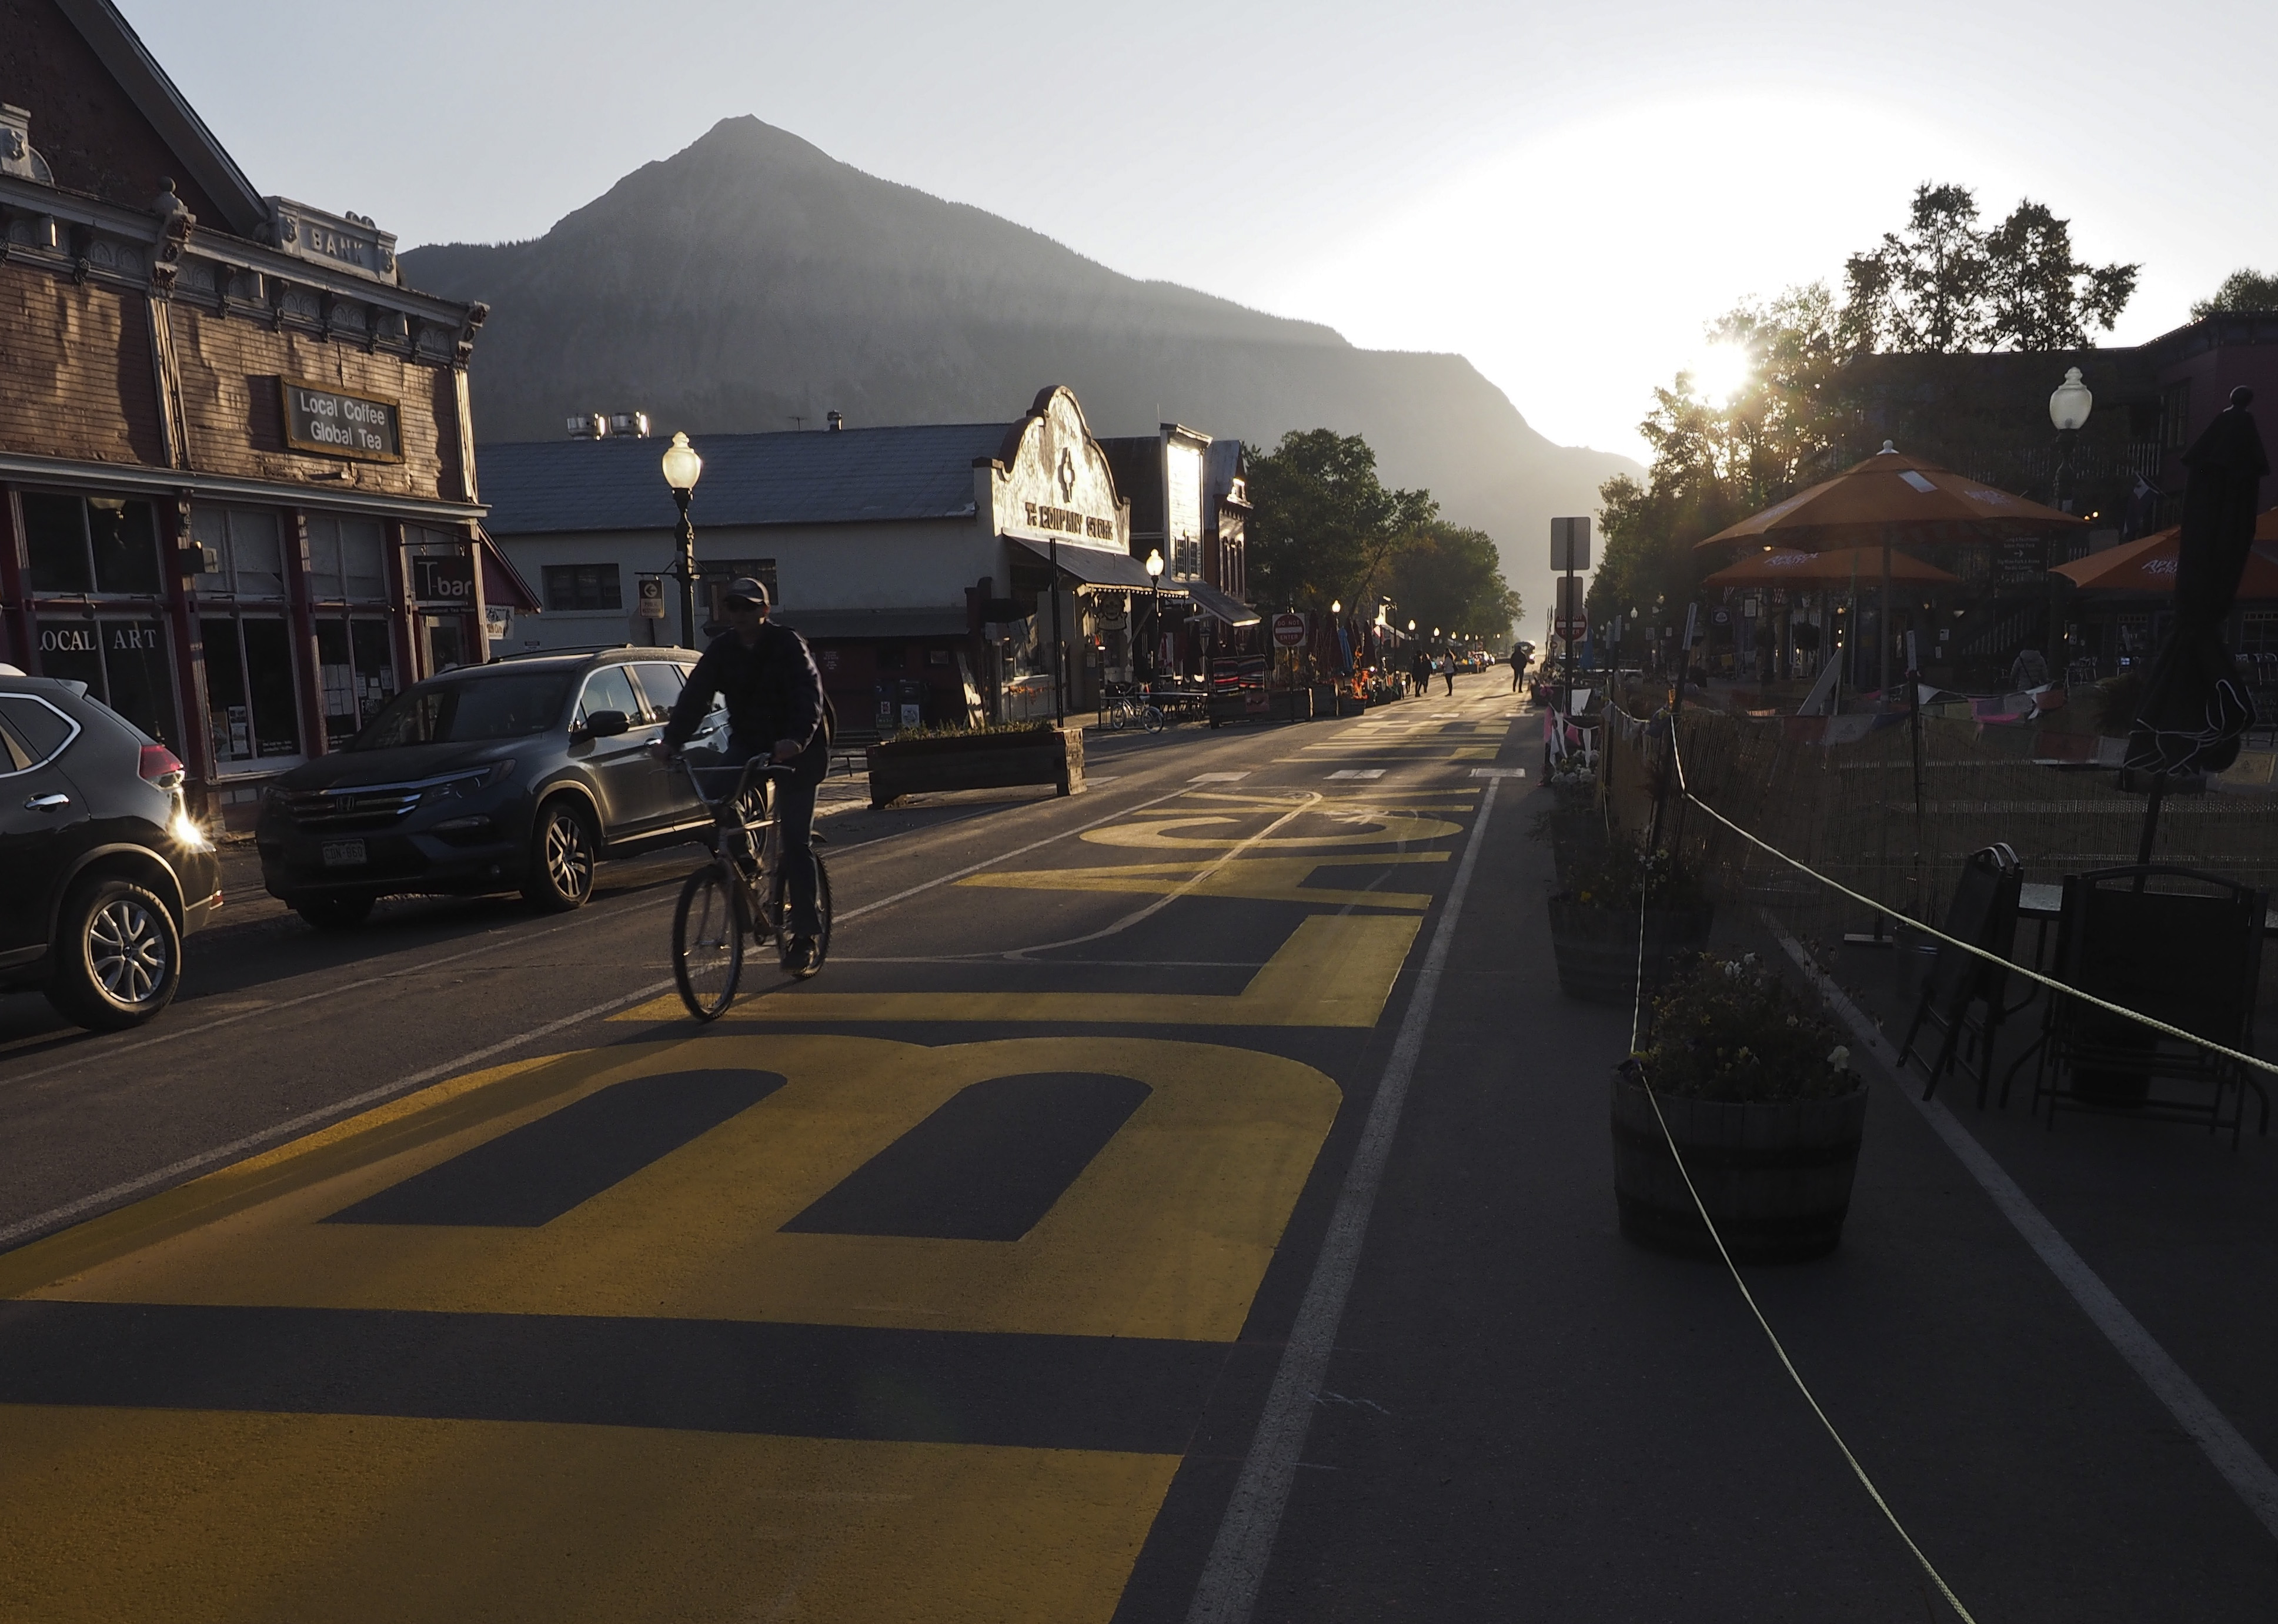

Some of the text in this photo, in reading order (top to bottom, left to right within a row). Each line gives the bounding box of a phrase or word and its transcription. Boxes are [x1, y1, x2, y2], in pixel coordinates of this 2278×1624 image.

[312, 228, 363, 264] BANK
[300, 392, 385, 426] Local Coffee
[310, 420, 382, 450] Global Tea
[1039, 506, 1083, 534] COMPANY
[1087, 516, 1114, 540] STORE
[417, 561, 472, 596] T-bar
[39, 629, 156, 651] OCAL ART
